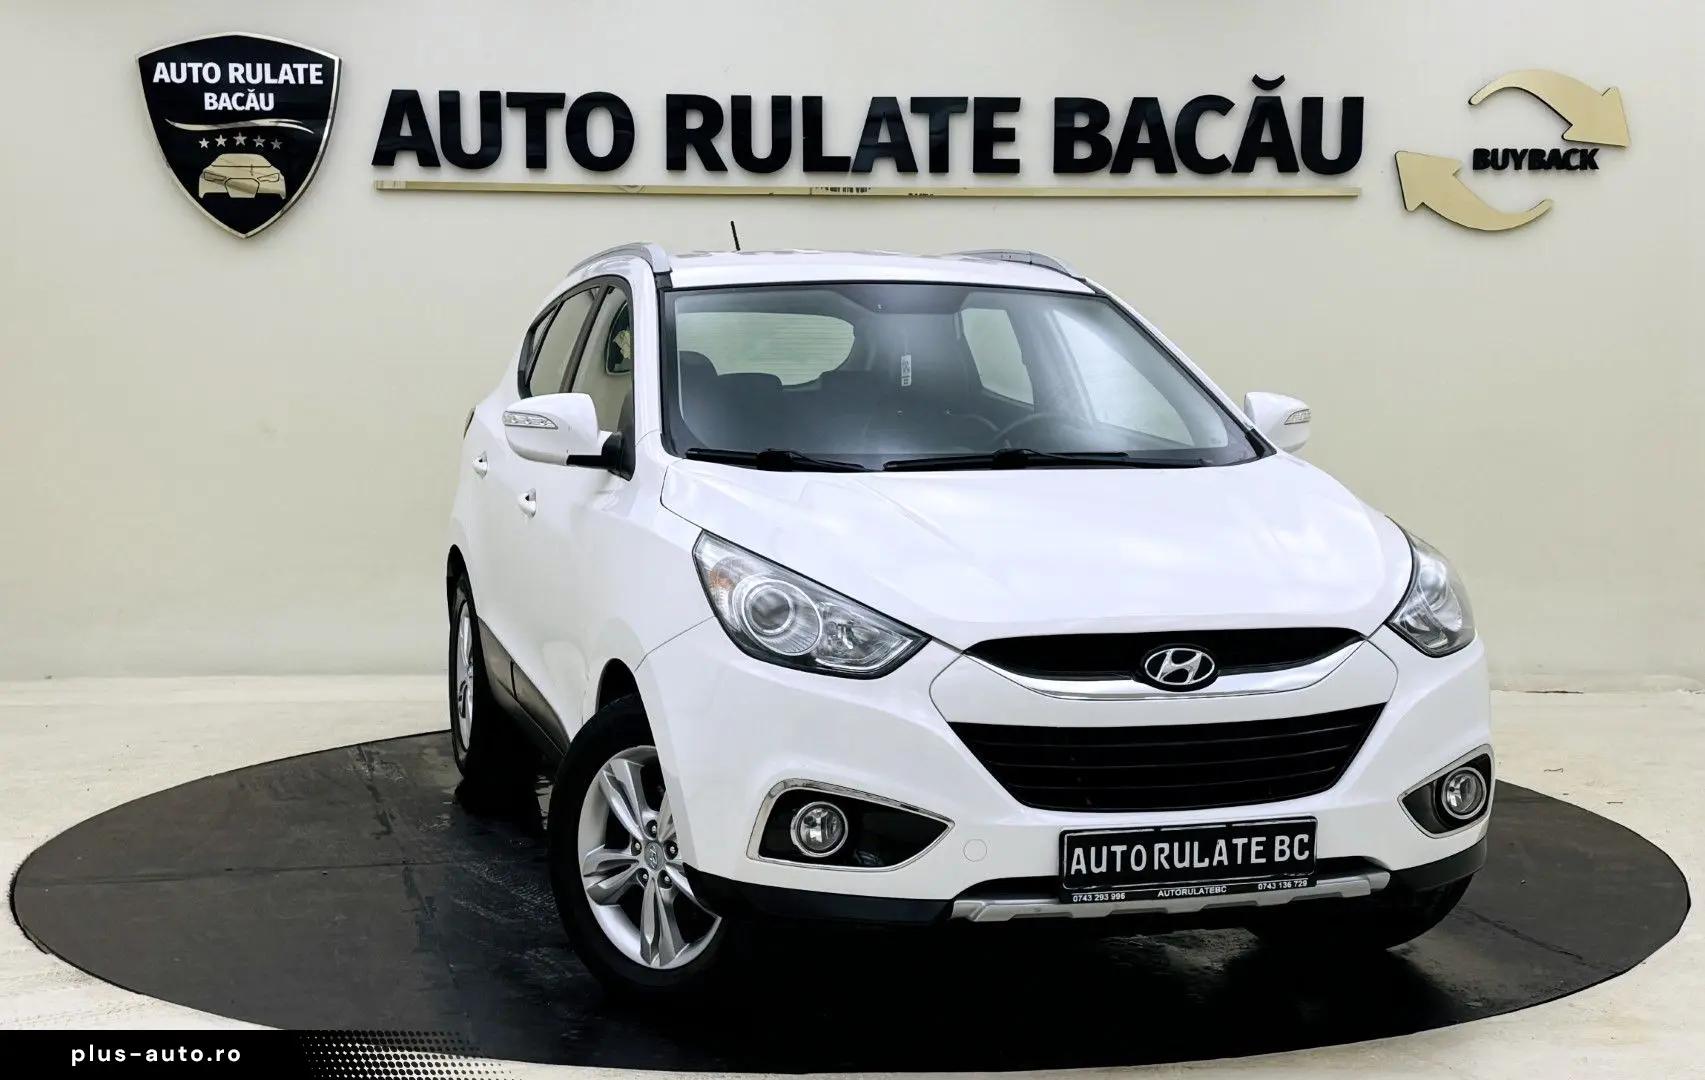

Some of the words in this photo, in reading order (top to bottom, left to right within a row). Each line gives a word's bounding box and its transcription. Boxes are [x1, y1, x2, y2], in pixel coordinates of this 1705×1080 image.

[152, 61, 222, 84] AUTO
[229, 62, 324, 85] RULATE
[203, 87, 275, 112] BACĂU
[371, 89, 636, 173] AUTO
[665, 93, 1022, 175] RULATE
[1052, 74, 1365, 176] BACĂU
[1472, 146, 1601, 172] BUYBACK
[1070, 844, 1147, 875] AUTO
[1153, 836, 1267, 870] RULATE
[1274, 833, 1310, 862] BC
[1072, 894, 1093, 903] 0743
[1094, 893, 1109, 902] 293
[1157, 885, 1228, 898] AUTORULATEBC
[1257, 882, 1277, 890] 0743
[1294, 879, 1308, 888] 729
